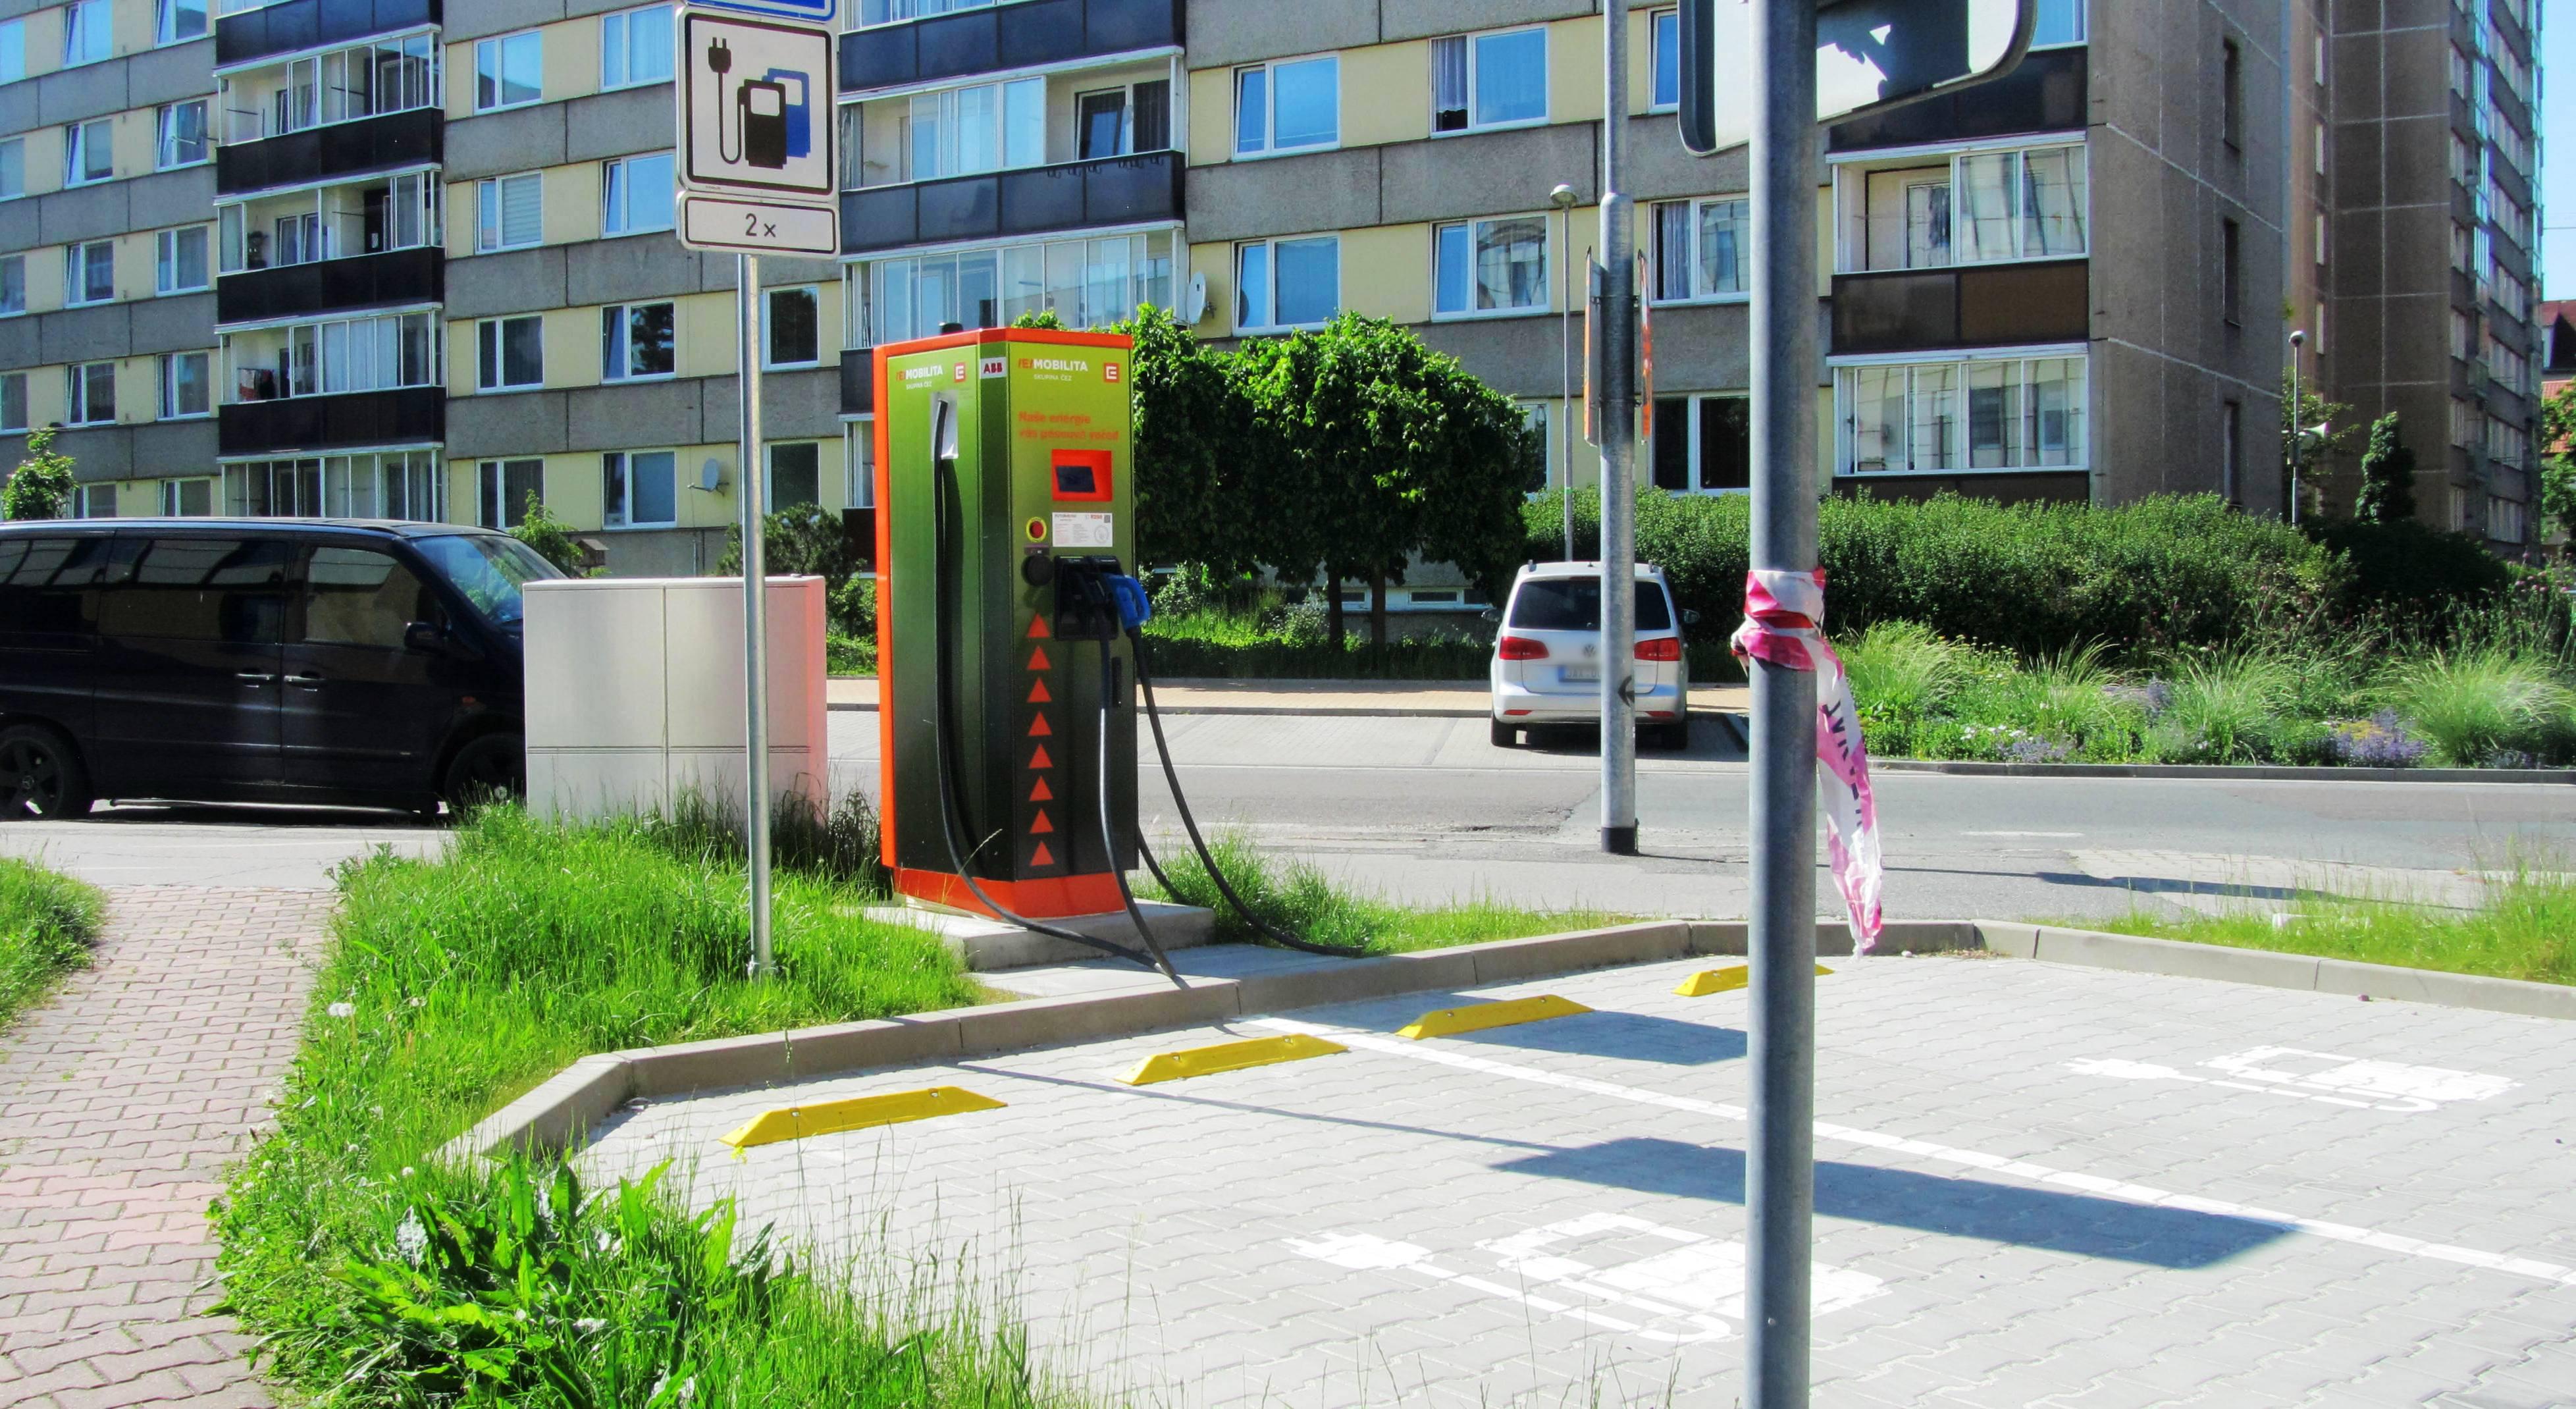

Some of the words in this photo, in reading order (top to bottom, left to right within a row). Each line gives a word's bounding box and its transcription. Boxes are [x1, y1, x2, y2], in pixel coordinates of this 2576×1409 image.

[745, 212, 758, 237] 2
[763, 223, 777, 238] x
[984, 362, 1003, 375] ABB
